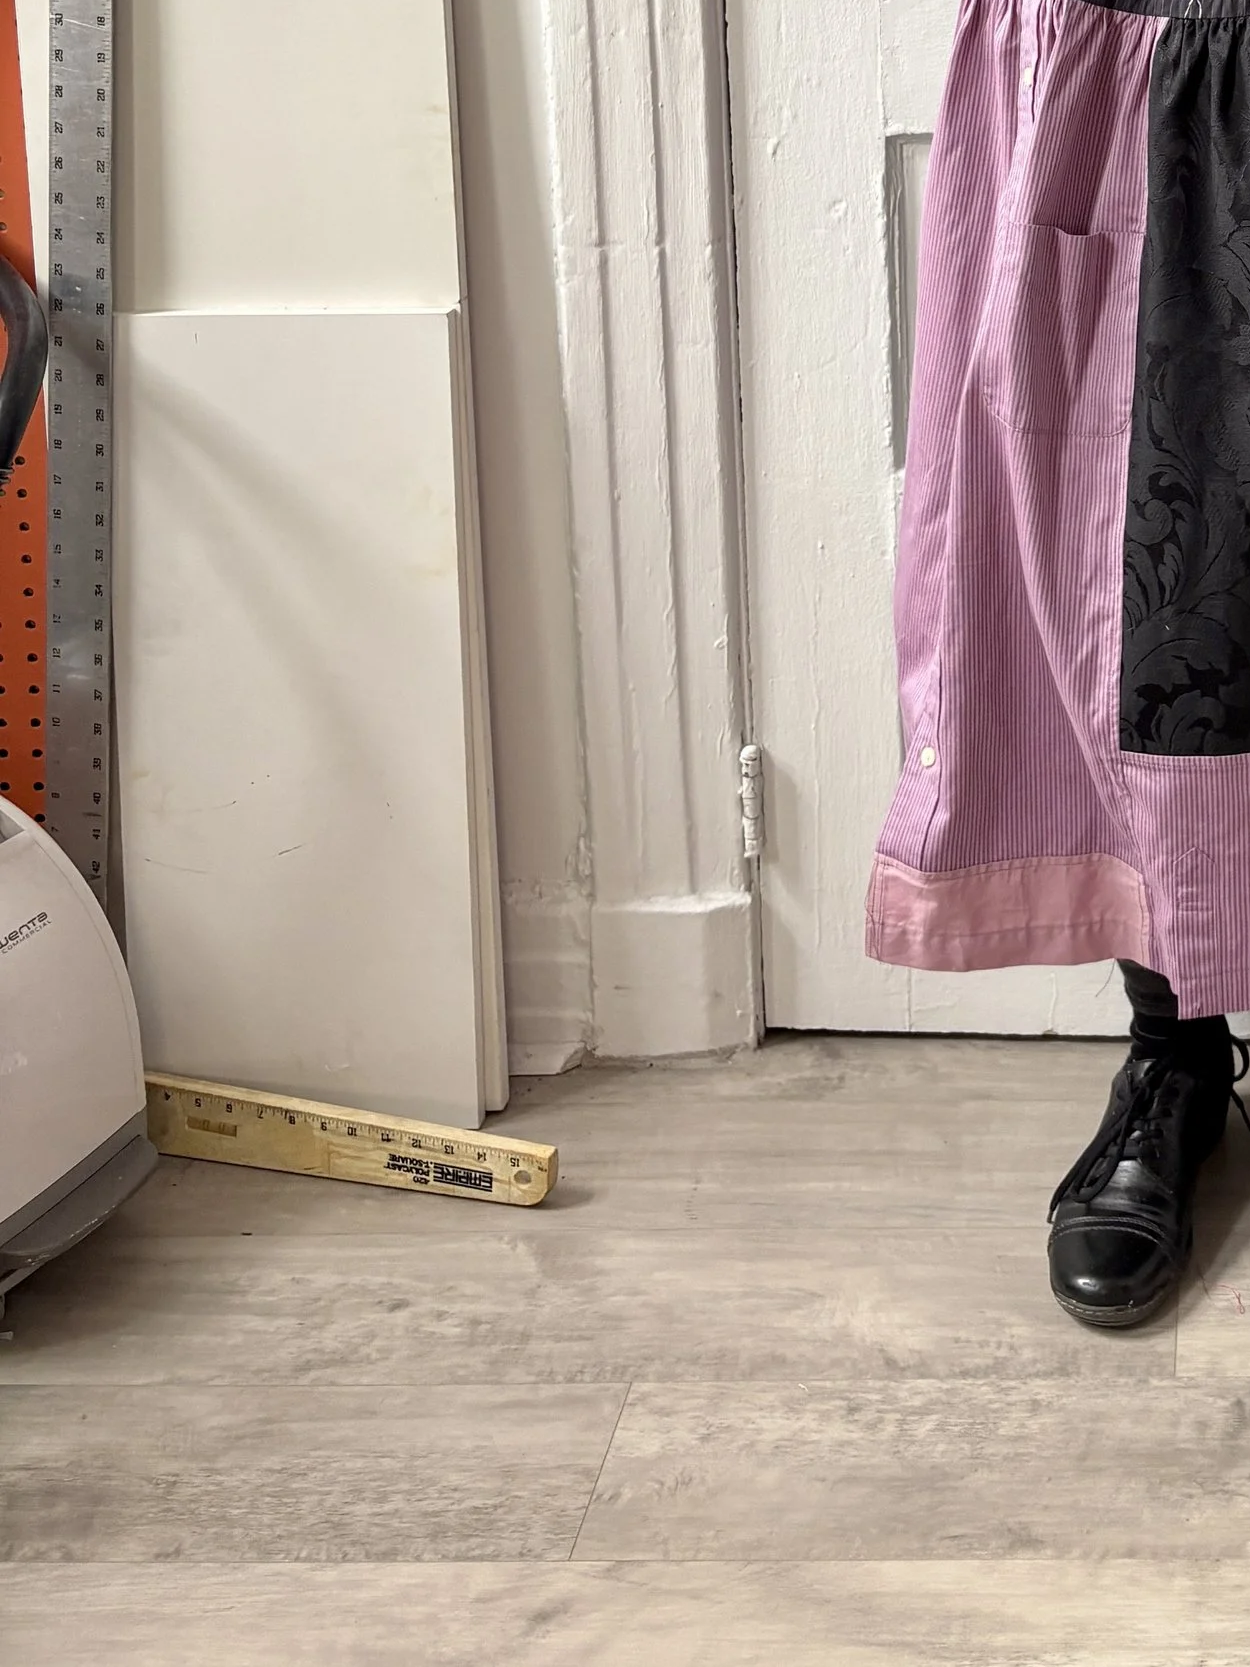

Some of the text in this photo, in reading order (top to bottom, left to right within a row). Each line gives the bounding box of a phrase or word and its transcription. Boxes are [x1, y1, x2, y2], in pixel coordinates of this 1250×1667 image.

[55, 13, 63, 26] 30
[97, 16, 105, 26] 18
[55, 49, 63, 62] 29
[97, 53, 105, 63] 19
[55, 85, 63, 98] 28
[97, 88, 105, 101] 20
[55, 122, 63, 134] 27
[97, 126, 105, 138] 21
[55, 157, 63, 169] 26
[97, 160, 105, 173] 22
[55, 192, 63, 204] 25
[97, 196, 105, 209] 23
[55, 228, 63, 241] 24
[97, 232, 104, 244] 24
[55, 263, 63, 276] 23
[96, 267, 104, 280] 25
[55, 298, 63, 311] 22
[96, 303, 104, 315] 26
[54, 336, 62, 347] 21
[54, 369, 62, 382] 20
[96, 374, 104, 386] 28
[54, 404, 62, 414] 19
[96, 409, 104, 421] 29
[54, 439, 62, 449] 18
[96, 444, 104, 457] 30
[54, 474, 62, 485] 17
[96, 481, 103, 492] 31
[53, 509, 61, 519] 16
[96, 514, 103, 526] 32
[95, 549, 103, 561] 33
[95, 584, 103, 597] 34
[53, 647, 61, 658] 12
[53, 683, 60, 693] 11
[52, 717, 60, 727] 10
[93, 792, 101, 804] 40
[92, 828, 101, 840] 41
[2, 920, 52, 954] COMMERCIAL
[164, 1092, 170, 1101] 4
[195, 1098, 202, 1107] 5
[226, 1104, 233, 1113] 6
[257, 1110, 264, 1119] 7
[288, 1116, 295, 1125] 8
[321, 1121, 328, 1131] 9
[347, 1126, 357, 1136] 10
[412, 1138, 422, 1149] 12
[444, 1145, 455, 1154] 13
[477, 1152, 487, 1161] 14
[510, 1157, 520, 1168] 15
[433, 1163, 493, 1192] EMPIRE
